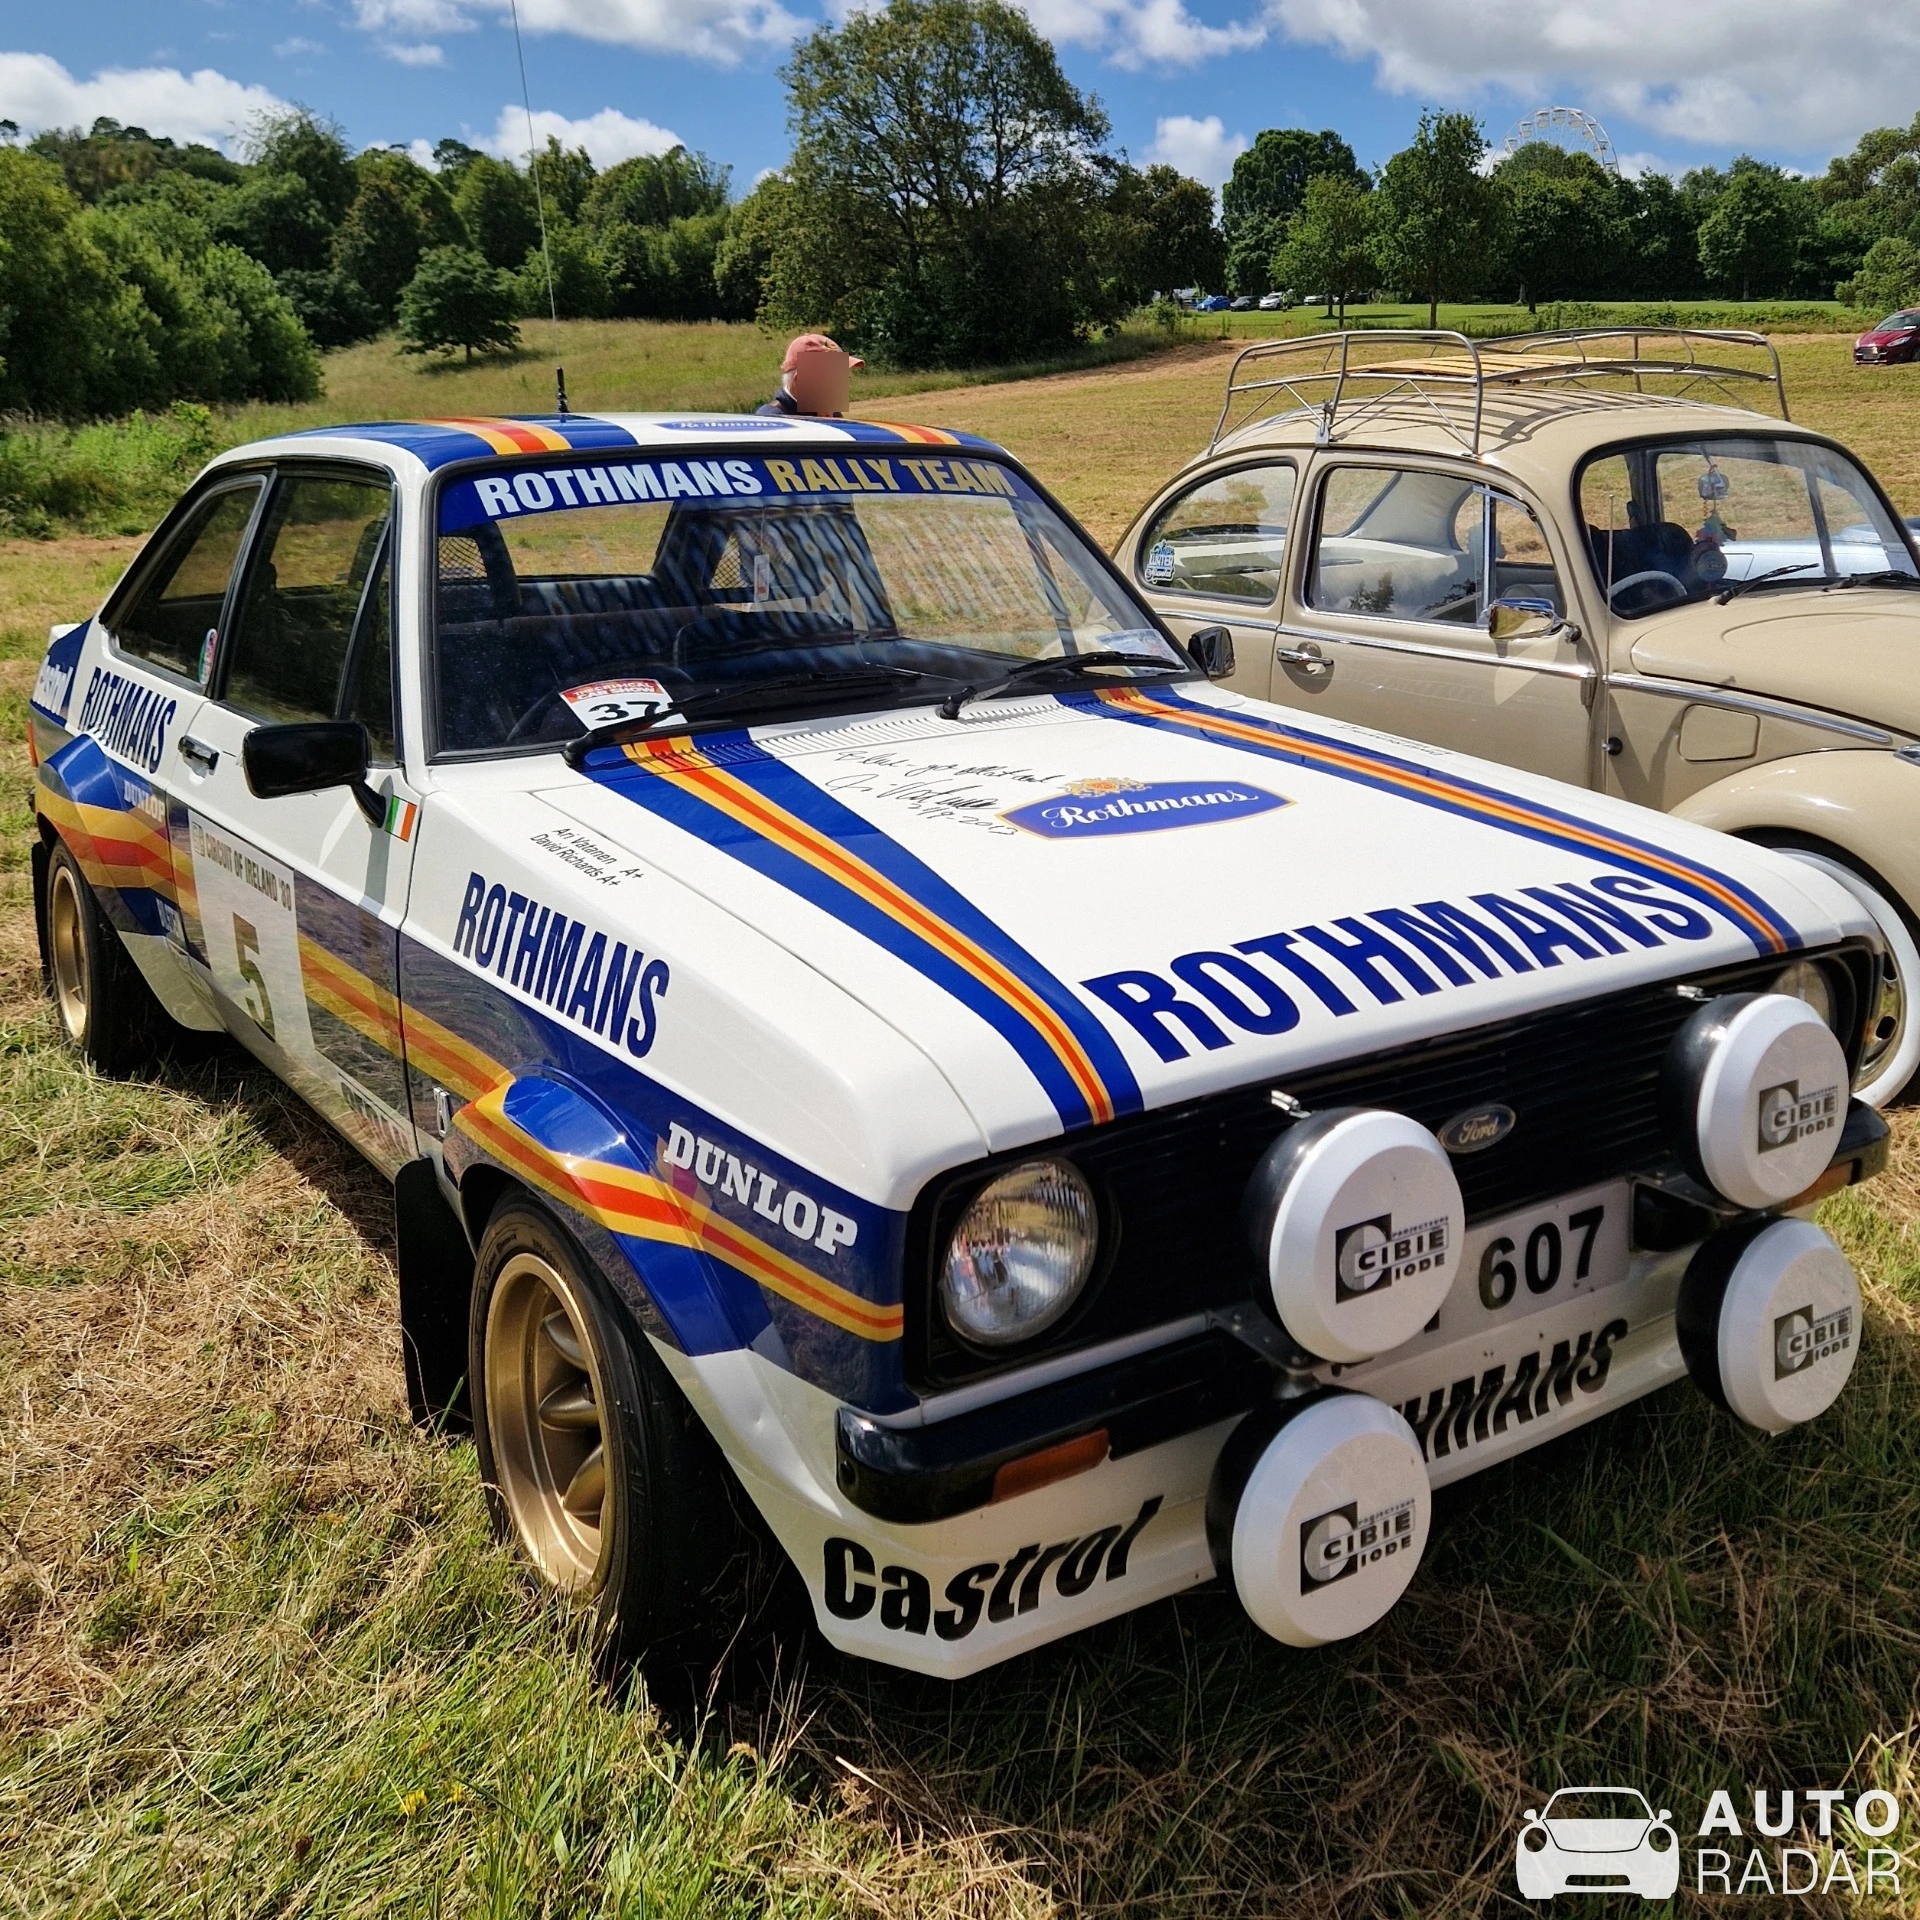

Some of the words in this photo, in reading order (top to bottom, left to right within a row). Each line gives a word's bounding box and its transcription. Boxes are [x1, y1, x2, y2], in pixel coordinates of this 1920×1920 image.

[474, 459, 763, 517] ROTHMANS
[763, 458, 902, 493] RALLY
[900, 457, 1017, 497] TEAM
[576, 690, 610, 701] CAR
[610, 687, 656, 695] SHOW
[587, 701, 661, 721] 37
[77, 666, 177, 775] ROTHMANS
[123, 779, 166, 823] DUNLOP
[1042, 788, 1259, 829] Rothmans
[205, 832, 234, 873] CIRCUIT
[233, 849, 244, 880] OF
[244, 856, 279, 902] IRELAND
[530, 833, 568, 853] David
[555, 848, 604, 878] Richards
[596, 875, 621, 886] A+
[552, 828, 580, 840] Ari
[571, 836, 618, 865] Vatanen
[619, 867, 645, 879] A+
[231, 911, 277, 1043] 5
[453, 871, 670, 1059] ROTHMANS
[1078, 875, 1715, 1064] ROTHMANS
[1458, 1114, 1500, 1145] Ford
[1773, 1094, 1836, 1128] CIBIE
[1799, 1115, 1836, 1138] IODE
[663, 1121, 858, 1256] DUNLOP
[1358, 1228, 1445, 1271] CIBIE
[1395, 1252, 1446, 1281] IODE
[1478, 1205, 1605, 1311] 607
[1789, 1315, 1850, 1353] CIBIE
[1815, 1336, 1850, 1361] IODE
[1395, 1317, 1629, 1465] HMANS
[1323, 1510, 1411, 1561] CIBIE
[1361, 1534, 1412, 1568] IODE
[822, 1495, 1165, 1642] Castrol
